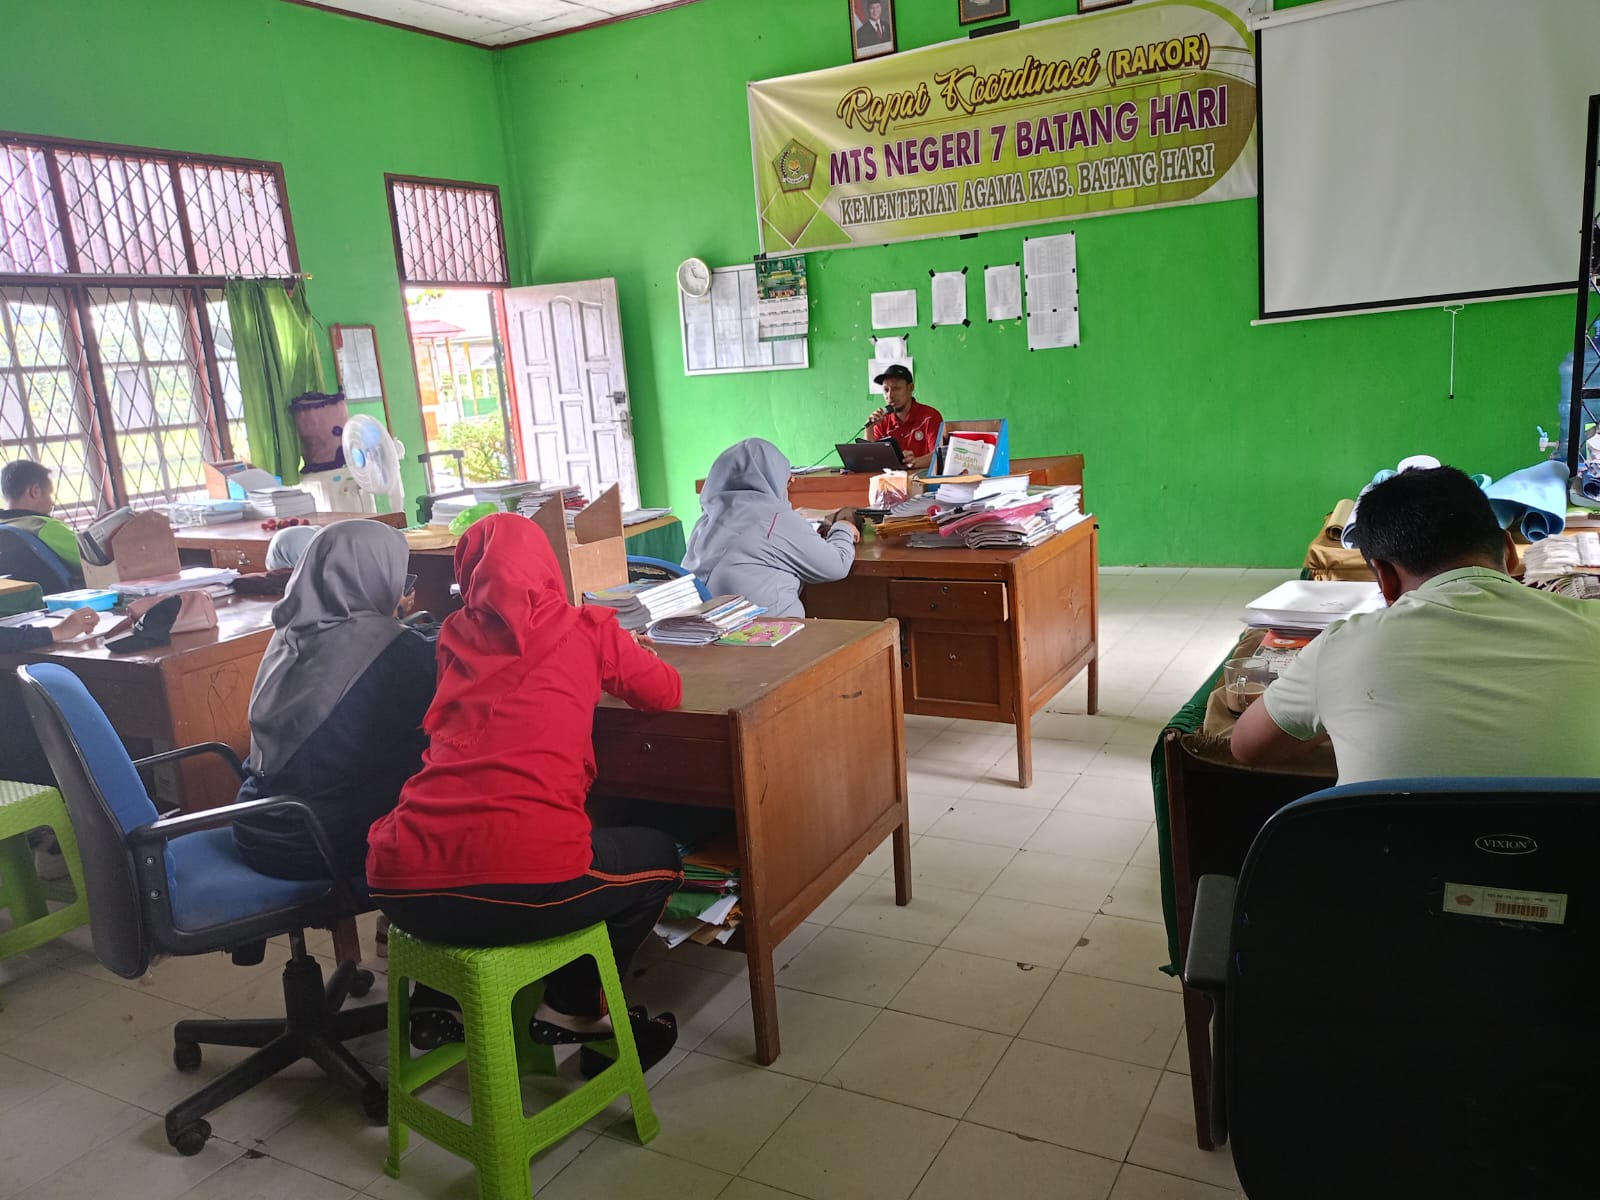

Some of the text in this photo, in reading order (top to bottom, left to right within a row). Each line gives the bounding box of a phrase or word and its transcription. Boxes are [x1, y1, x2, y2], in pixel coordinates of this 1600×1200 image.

[837, 33, 1210, 136] Rapat Koordinasi (RAKOR)
[830, 85, 1228, 186] MTS NEGERI 7 BATANG HARI
[840, 144, 1216, 226] KEMENTERIAN AGAMA KAB. BATANG HARI
